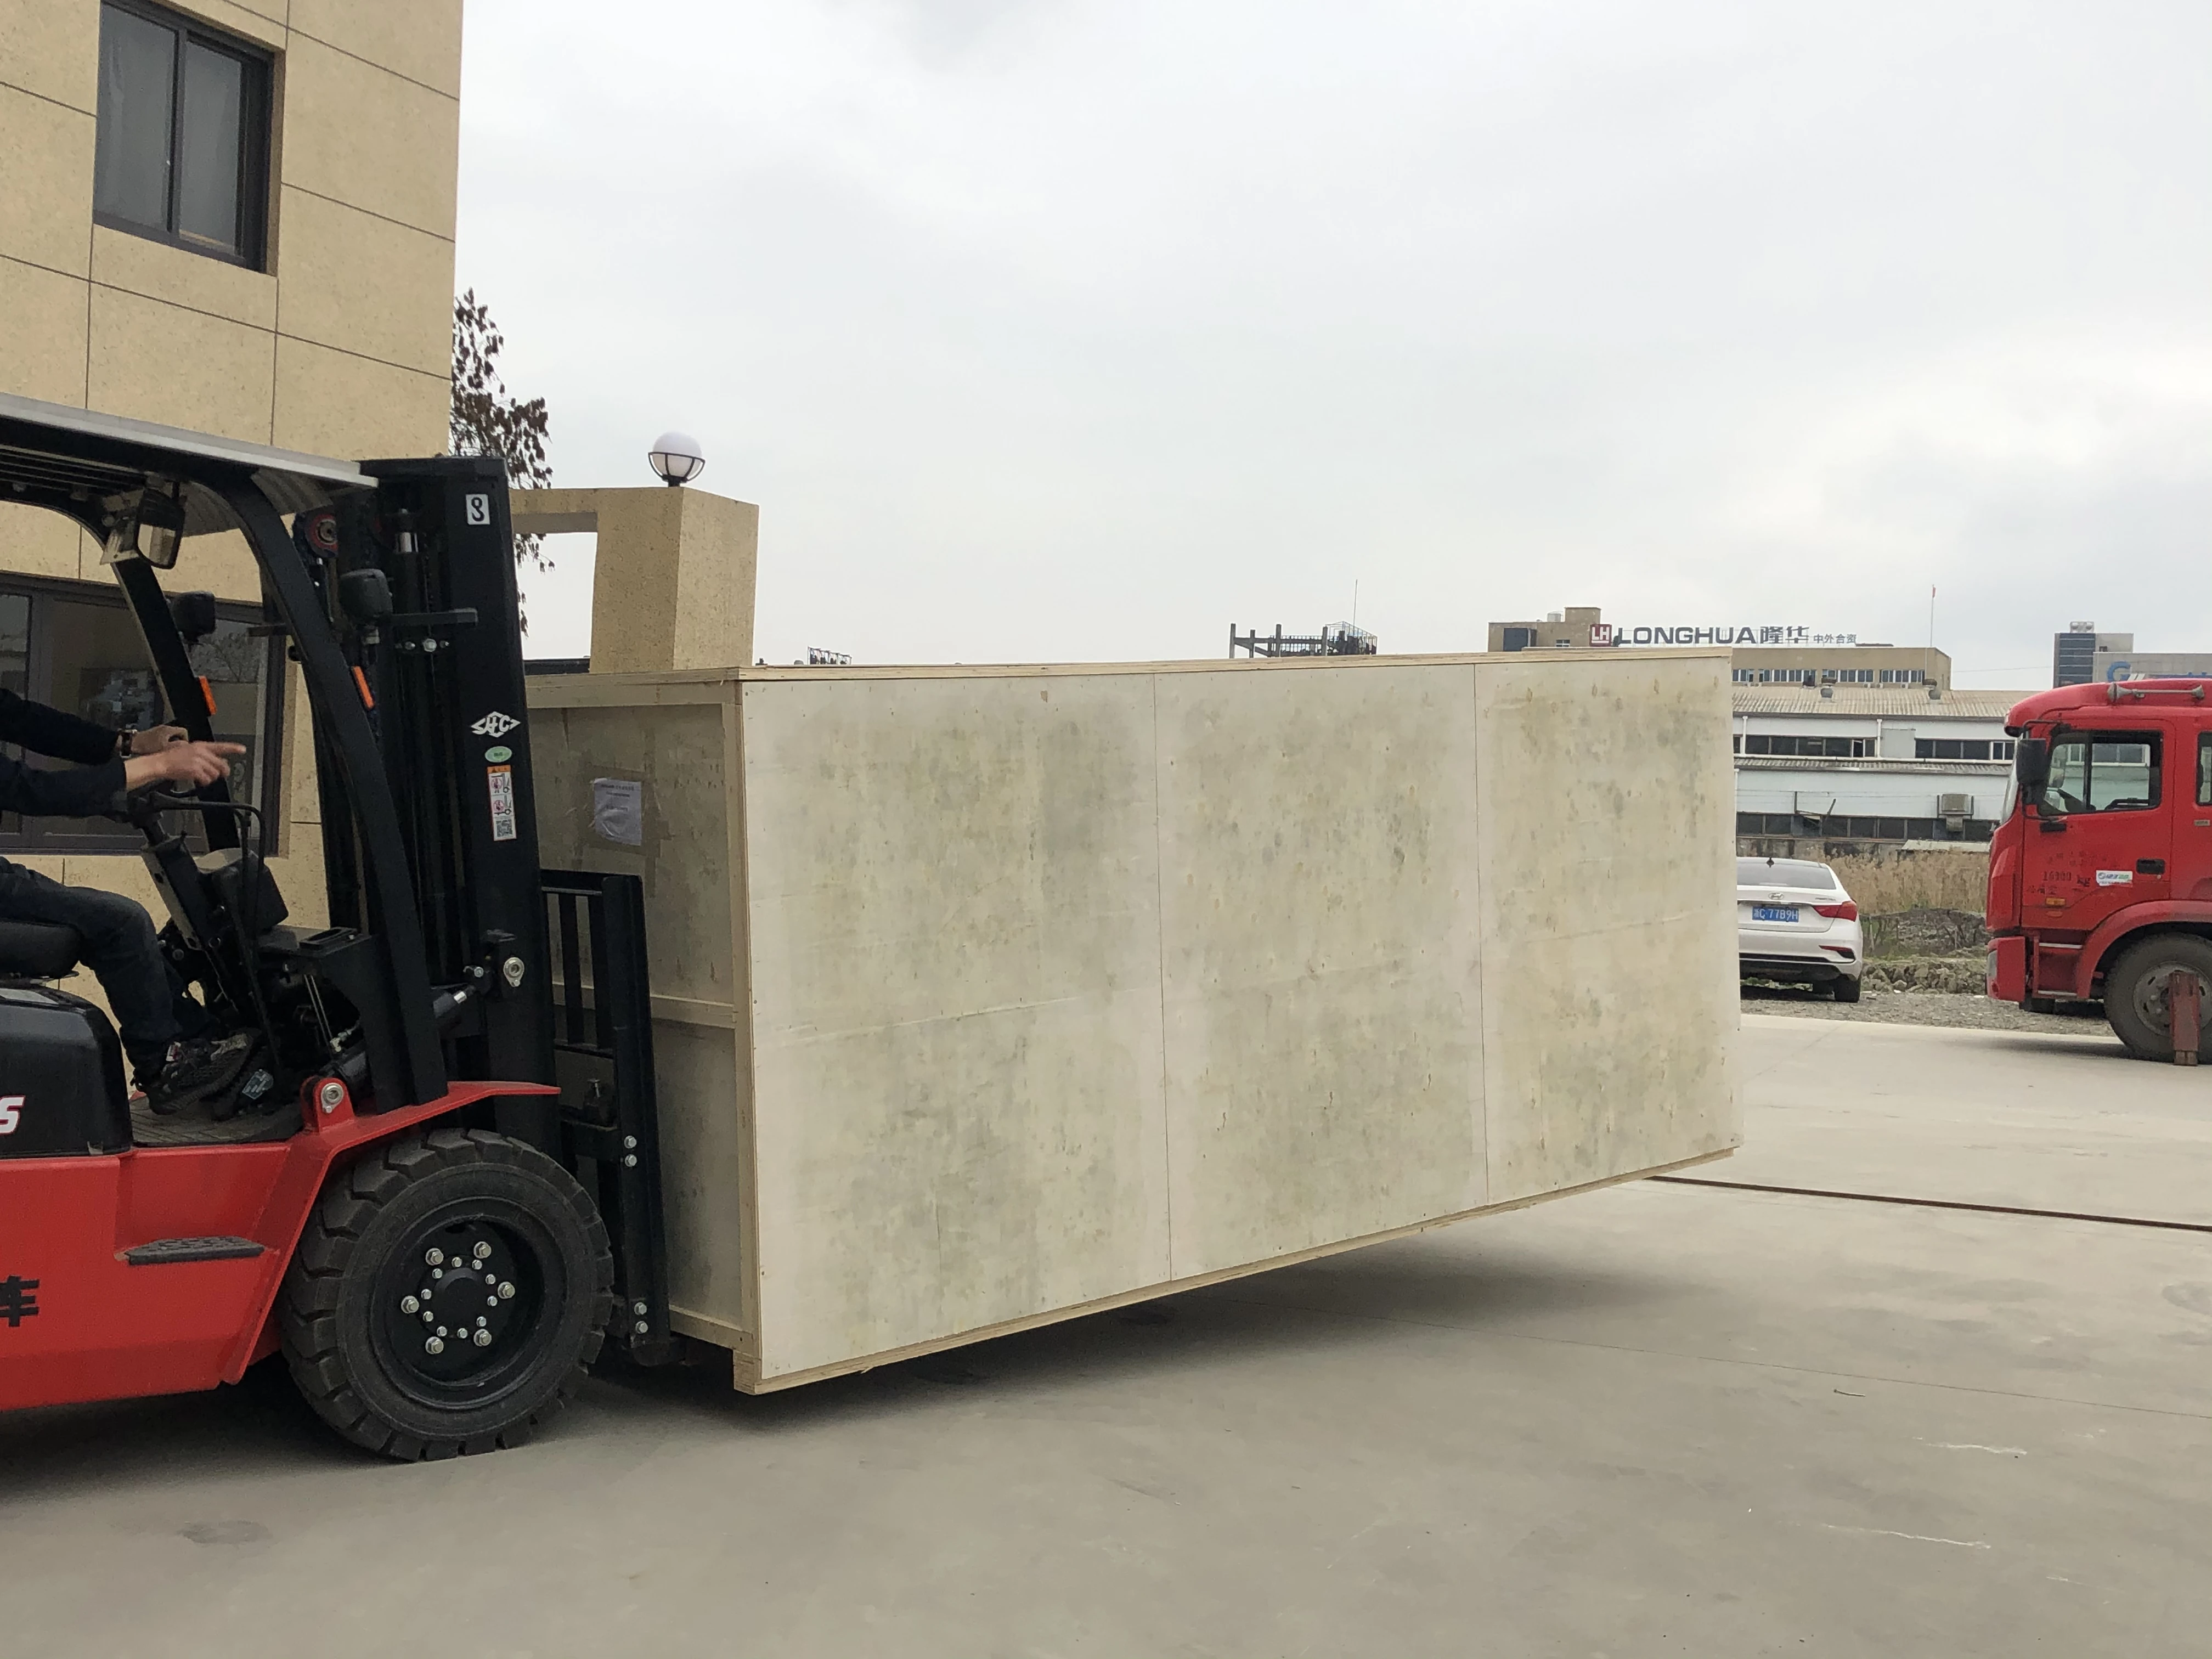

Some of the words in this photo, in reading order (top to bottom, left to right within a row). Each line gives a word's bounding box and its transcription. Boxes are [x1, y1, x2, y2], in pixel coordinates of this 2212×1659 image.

[1591, 626, 1610, 643] LH
[1618, 627, 1756, 644] LONGHUA
[1760, 626, 1809, 644] 隆华
[1813, 634, 1857, 644] 中外合资
